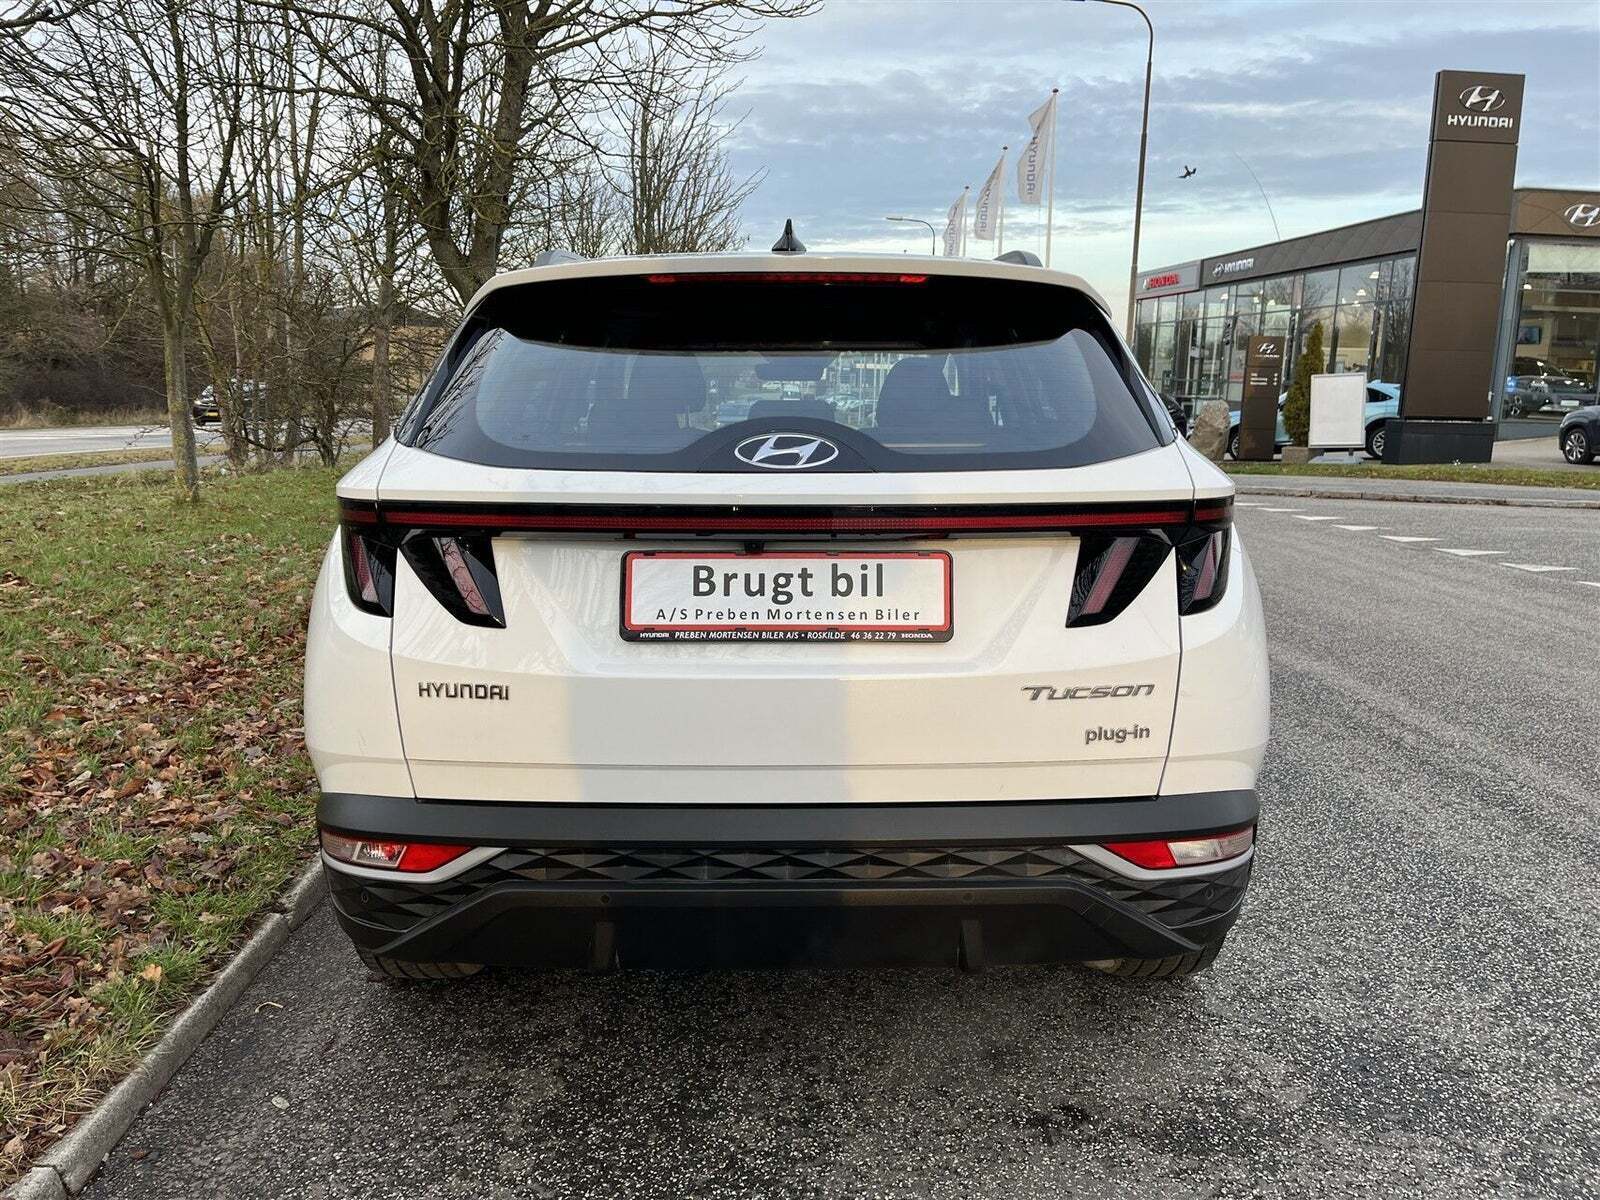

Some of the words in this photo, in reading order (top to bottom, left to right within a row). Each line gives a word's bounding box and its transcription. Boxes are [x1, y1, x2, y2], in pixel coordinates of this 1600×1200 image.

[1447, 114, 1514, 128] HYUNDAI
[692, 564, 814, 605] Brugt
[830, 562, 884, 598] bil
[656, 608, 689, 622] A/S
[695, 608, 760, 621] Preben
[767, 608, 868, 622] Mortensen
[875, 607, 921, 622] Biler
[674, 631, 707, 640] PREBEN
[709, 631, 760, 640] MORTENSEN
[761, 631, 784, 640] BILER
[807, 631, 846, 640] ROSKILDE
[850, 631, 860, 640] 46
[862, 631, 872, 640] 36
[874, 631, 884, 640] 22
[887, 631, 897, 640] 79
[418, 682, 509, 700] HYUNDAI
[1085, 724, 1150, 744] plug-in
